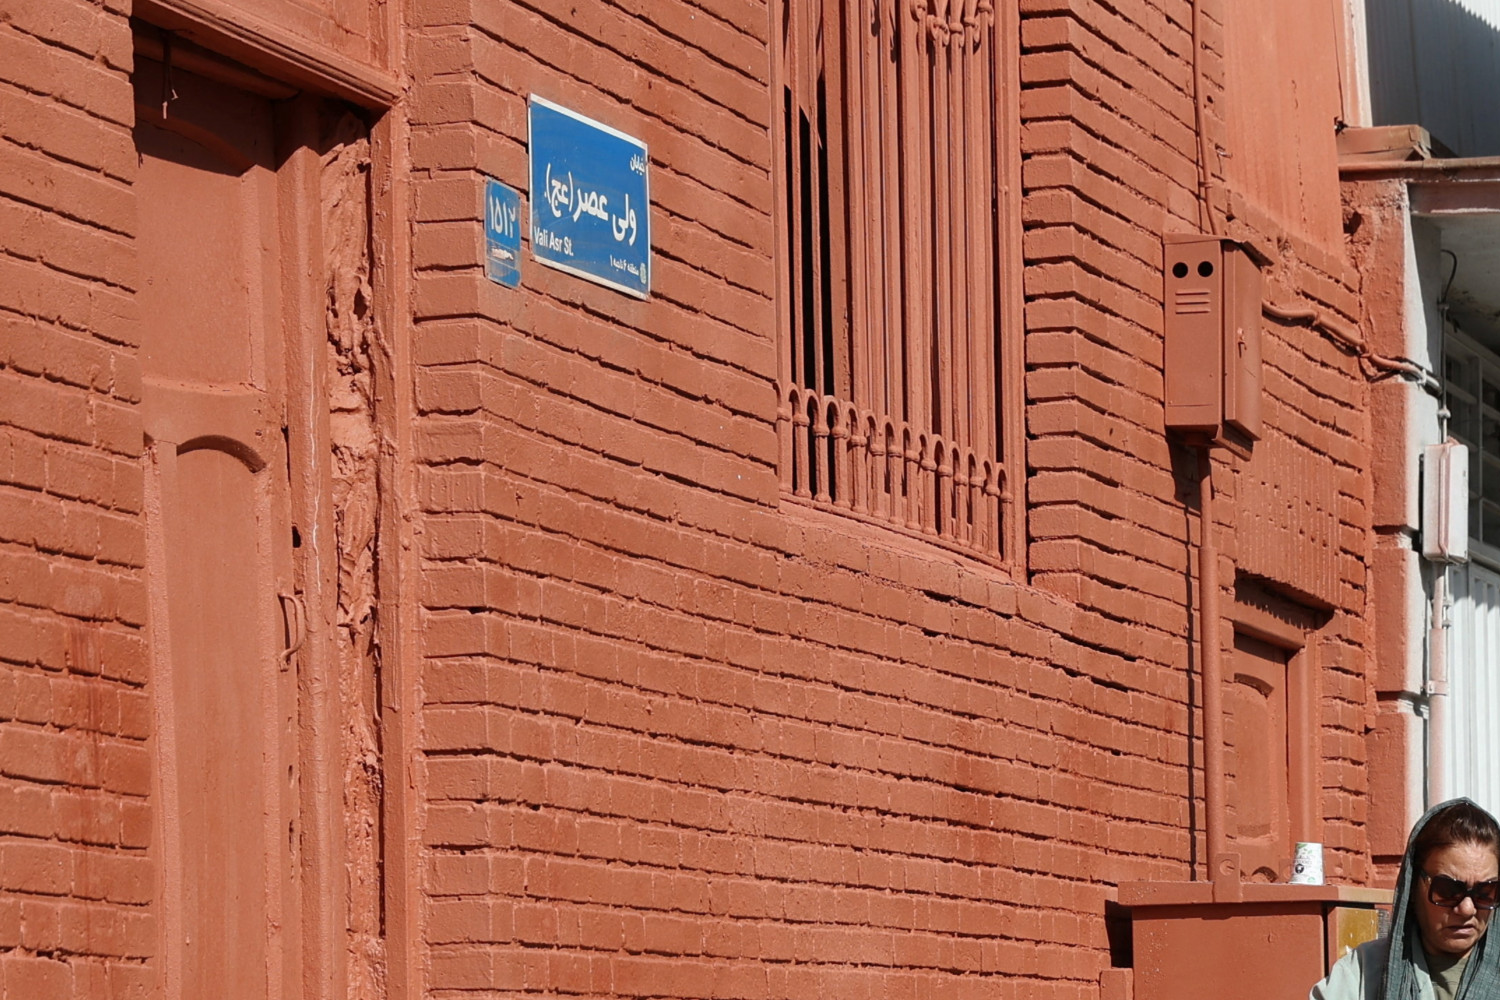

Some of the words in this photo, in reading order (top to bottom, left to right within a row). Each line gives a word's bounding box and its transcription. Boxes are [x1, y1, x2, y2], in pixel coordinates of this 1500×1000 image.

[630, 153, 646, 176] خیابان
[573, 188, 609, 222] عصر
[612, 193, 637, 246] ولی
[533, 226, 549, 247] Vali
[549, 231, 563, 253] Asr
[563, 236, 575, 257] St.
